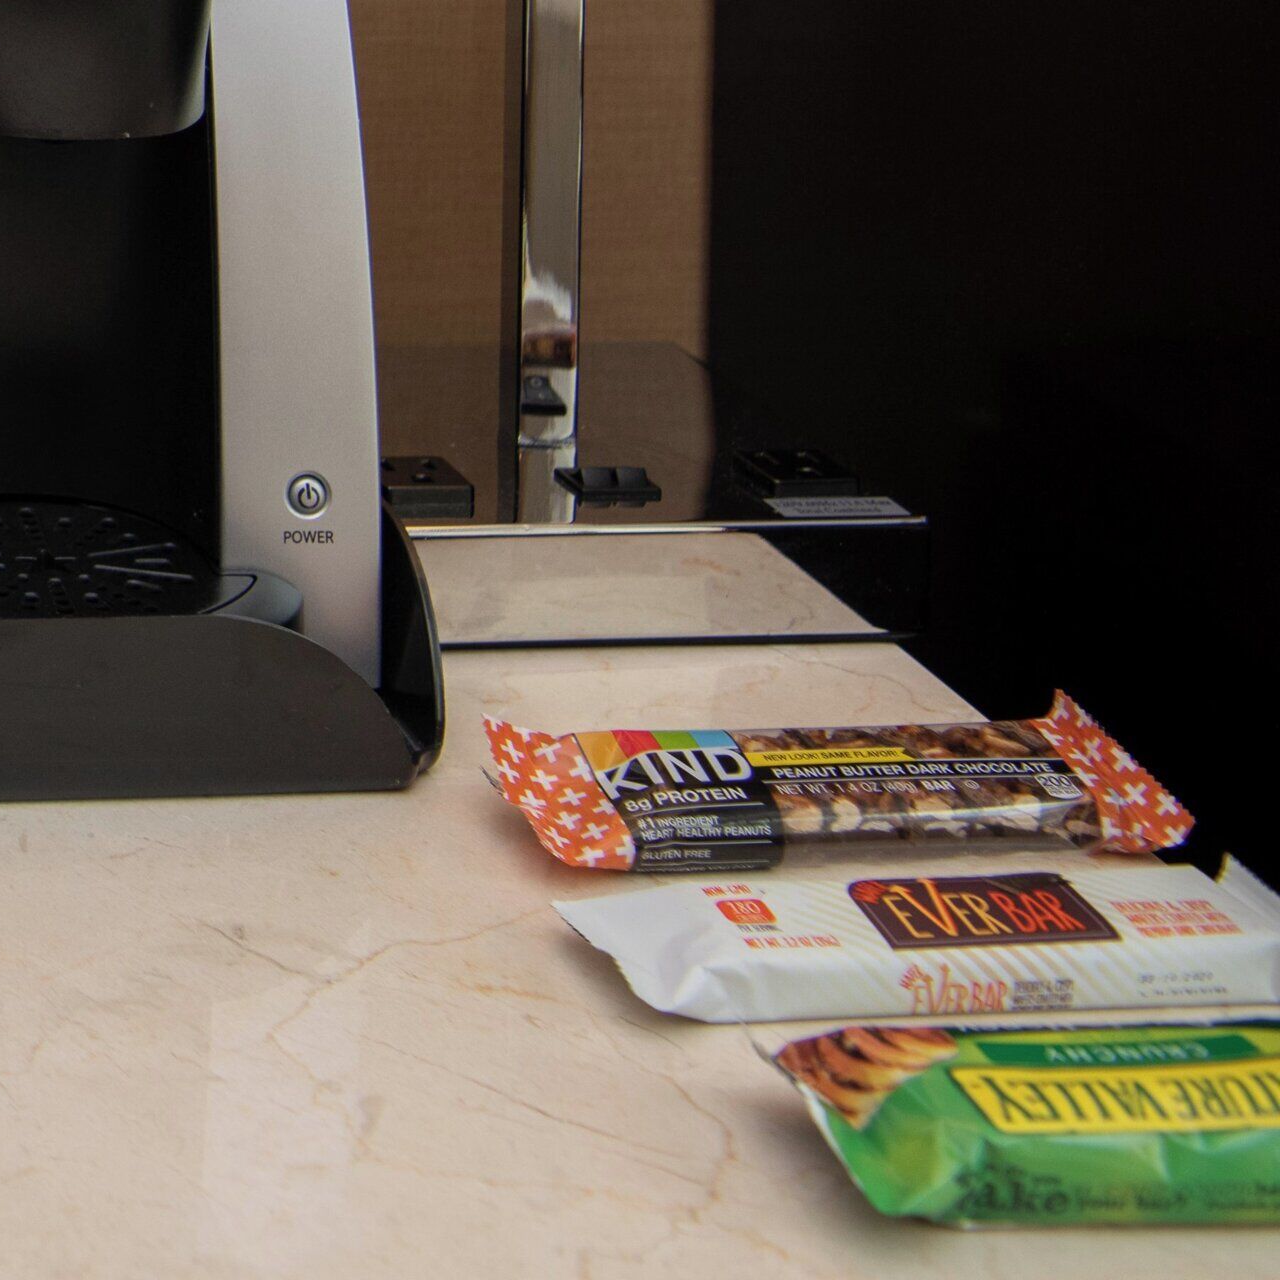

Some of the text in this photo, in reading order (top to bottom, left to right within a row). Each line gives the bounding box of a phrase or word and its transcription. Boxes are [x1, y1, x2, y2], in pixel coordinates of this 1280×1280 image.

[283, 530, 334, 544] POWER
[763, 749, 898, 762] NEW LOOK! SAME FLAVOR!
[595, 746, 753, 800] KIND
[770, 761, 1055, 780] PEANUT BUTTER DARK CHOCOLATE
[774, 783, 804, 795] NET
[860, 781, 883, 793] OZ
[920, 778, 956, 791] BAR
[1039, 773, 1073, 787] 200
[624, 786, 748, 815] 8g PROTEIN
[657, 815, 720, 829] INGREDIENT
[641, 824, 773, 842] HEART HEALTHY PEANUTS
[641, 848, 712, 861] GLUTEN FREE
[1044, 1041, 1211, 1064] CRUNCHY
[979, 1075, 1170, 1123] VALLEY
